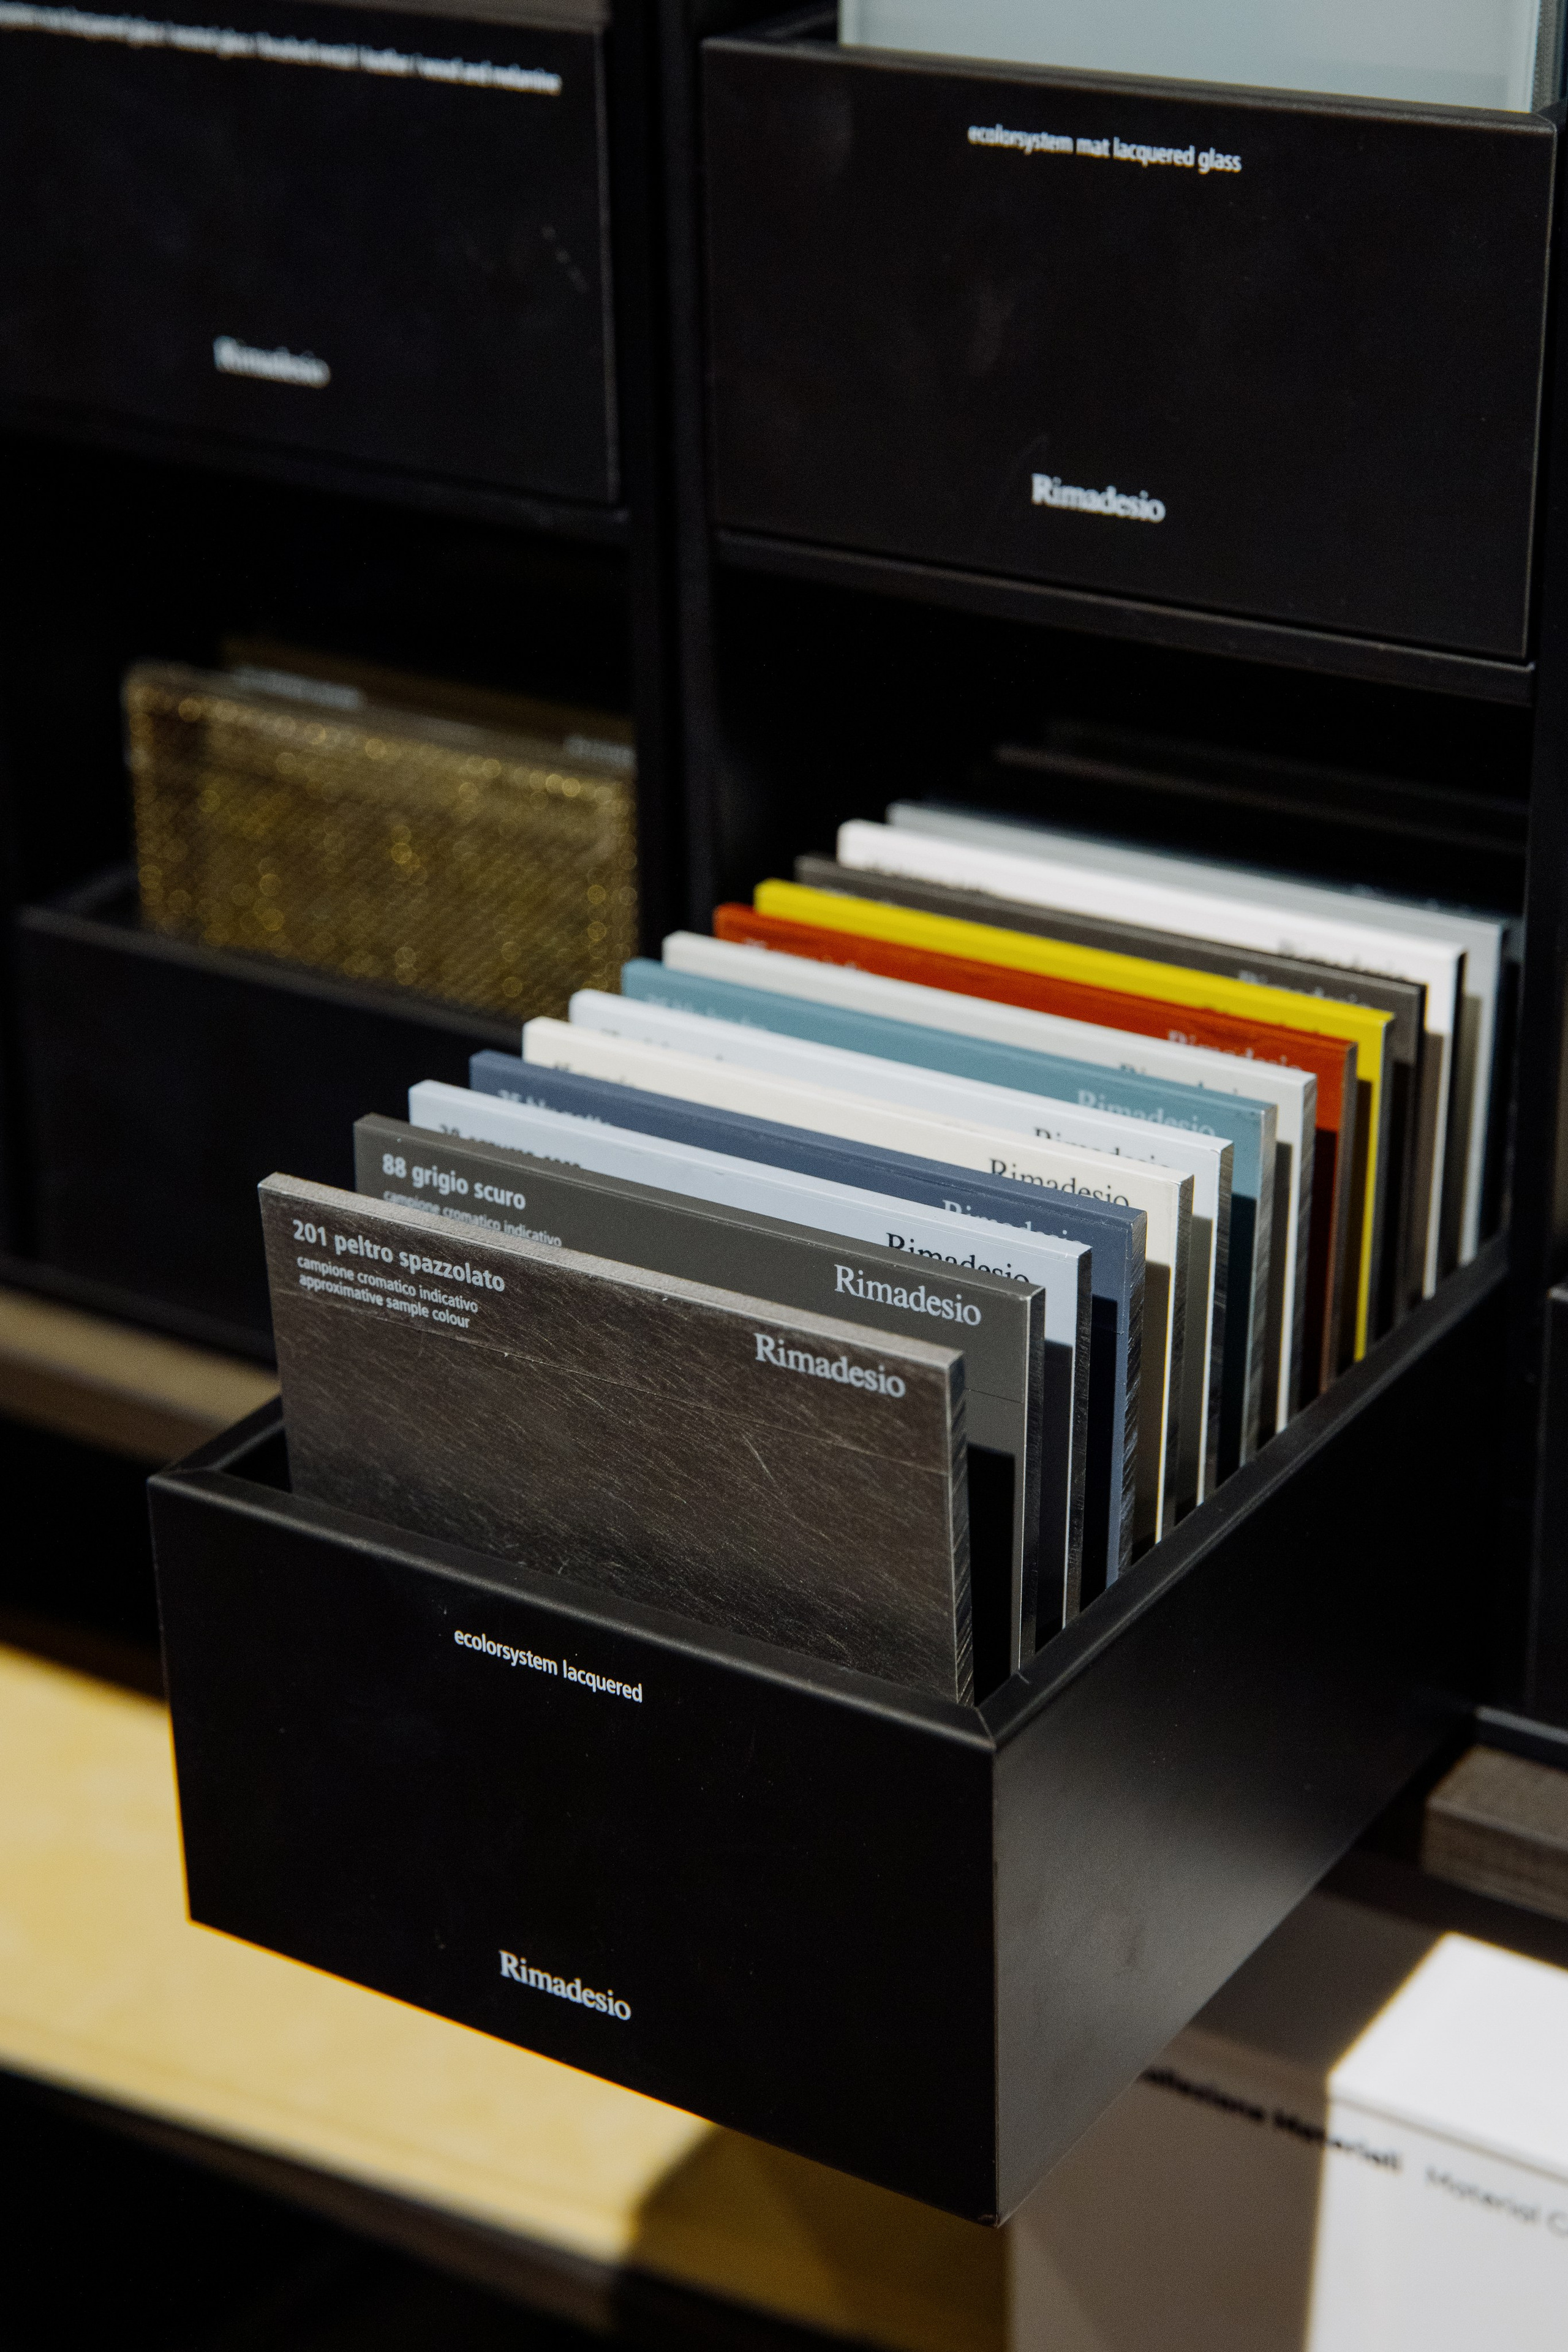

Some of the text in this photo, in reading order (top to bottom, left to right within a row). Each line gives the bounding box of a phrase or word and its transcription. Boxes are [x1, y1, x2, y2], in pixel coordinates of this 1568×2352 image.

[967, 124, 1242, 174] ecolorsystem mat lacquered glass
[1031, 472, 1166, 524] Rimadesio
[382, 1153, 526, 1210] 88 grigio scuro
[293, 1219, 505, 1292] 201 peltro spazzolato
[503, 1219, 562, 1248] indicativo
[296, 1256, 478, 1313] campione cromatico indicativo
[299, 1274, 470, 1329] approximative sample colour
[834, 1264, 981, 1326] Rimadesio
[754, 1332, 906, 1398] Rimadesio
[454, 1630, 643, 1703] ecolorsystem lacquered
[499, 1949, 631, 2021] Rimadesio
